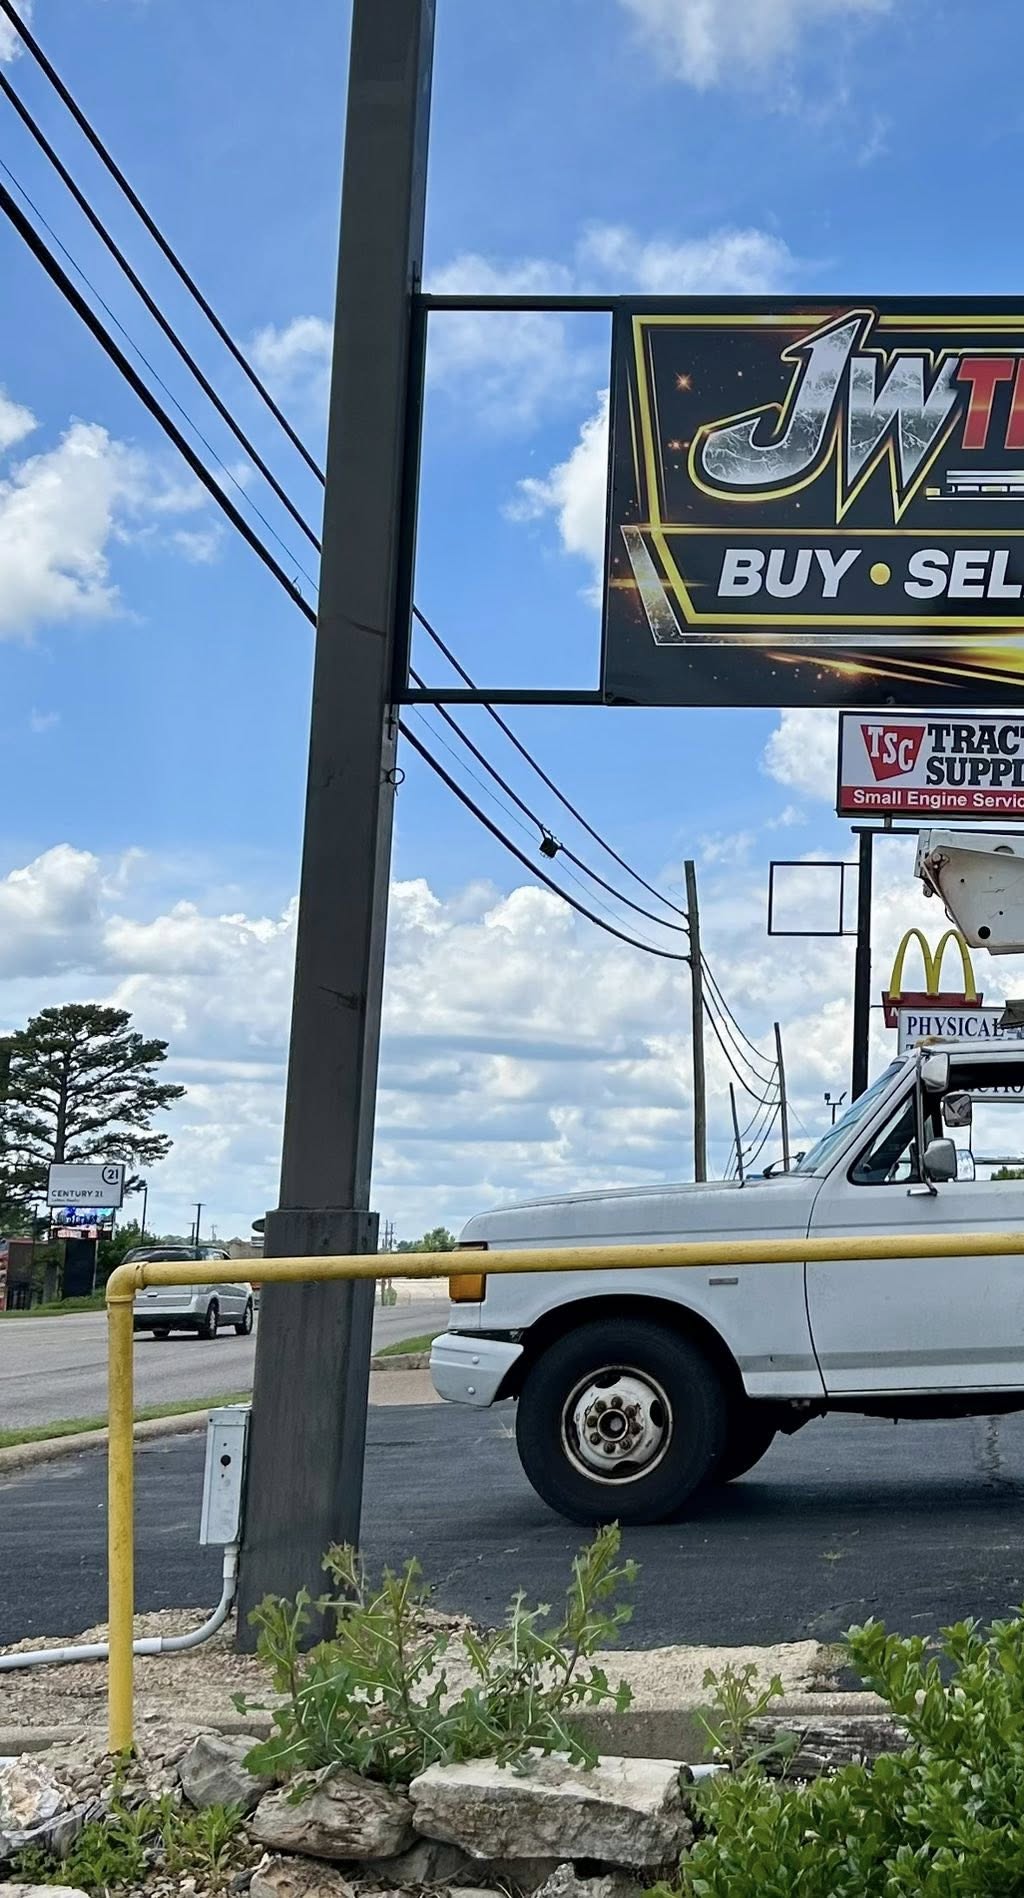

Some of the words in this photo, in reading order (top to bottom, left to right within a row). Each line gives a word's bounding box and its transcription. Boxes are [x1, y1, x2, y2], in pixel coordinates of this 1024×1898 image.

[717, 548, 863, 599] BUY
[867, 725, 914, 772] TSC
[853, 789, 901, 806] Small
[907, 791, 968, 808] Engine
[51, 1189, 93, 1198] CENTURY
[94, 1190, 103, 1198] 21
